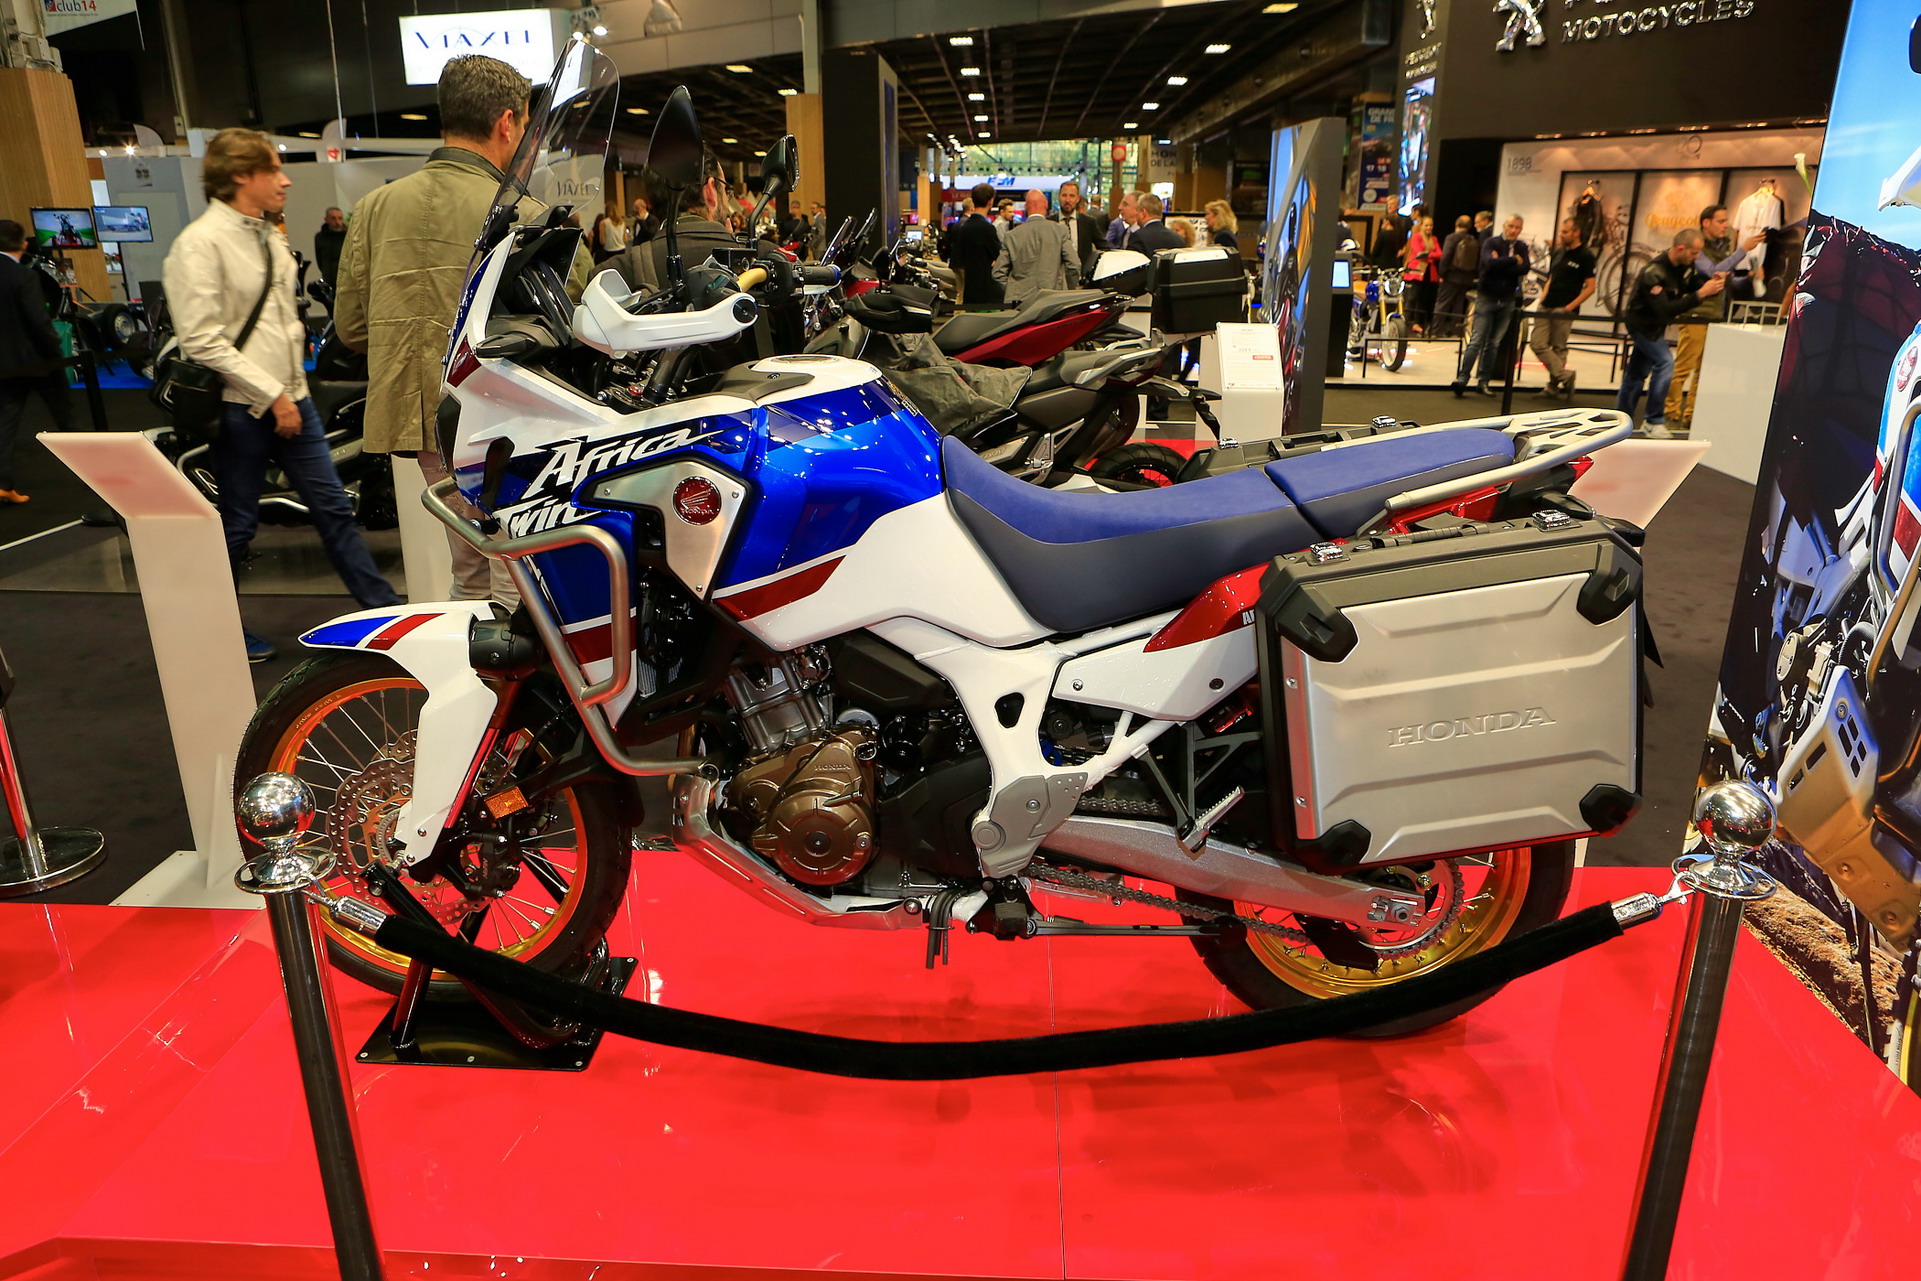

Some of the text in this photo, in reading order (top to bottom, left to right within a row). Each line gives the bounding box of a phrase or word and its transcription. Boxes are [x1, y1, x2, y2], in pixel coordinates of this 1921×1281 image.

[1561, 0, 1755, 43] MOTOCYCLES
[1507, 156, 1532, 171] 1898
[521, 428, 726, 500] Africa
[493, 495, 601, 539] Twin
[1388, 706, 1557, 748] HONDA
